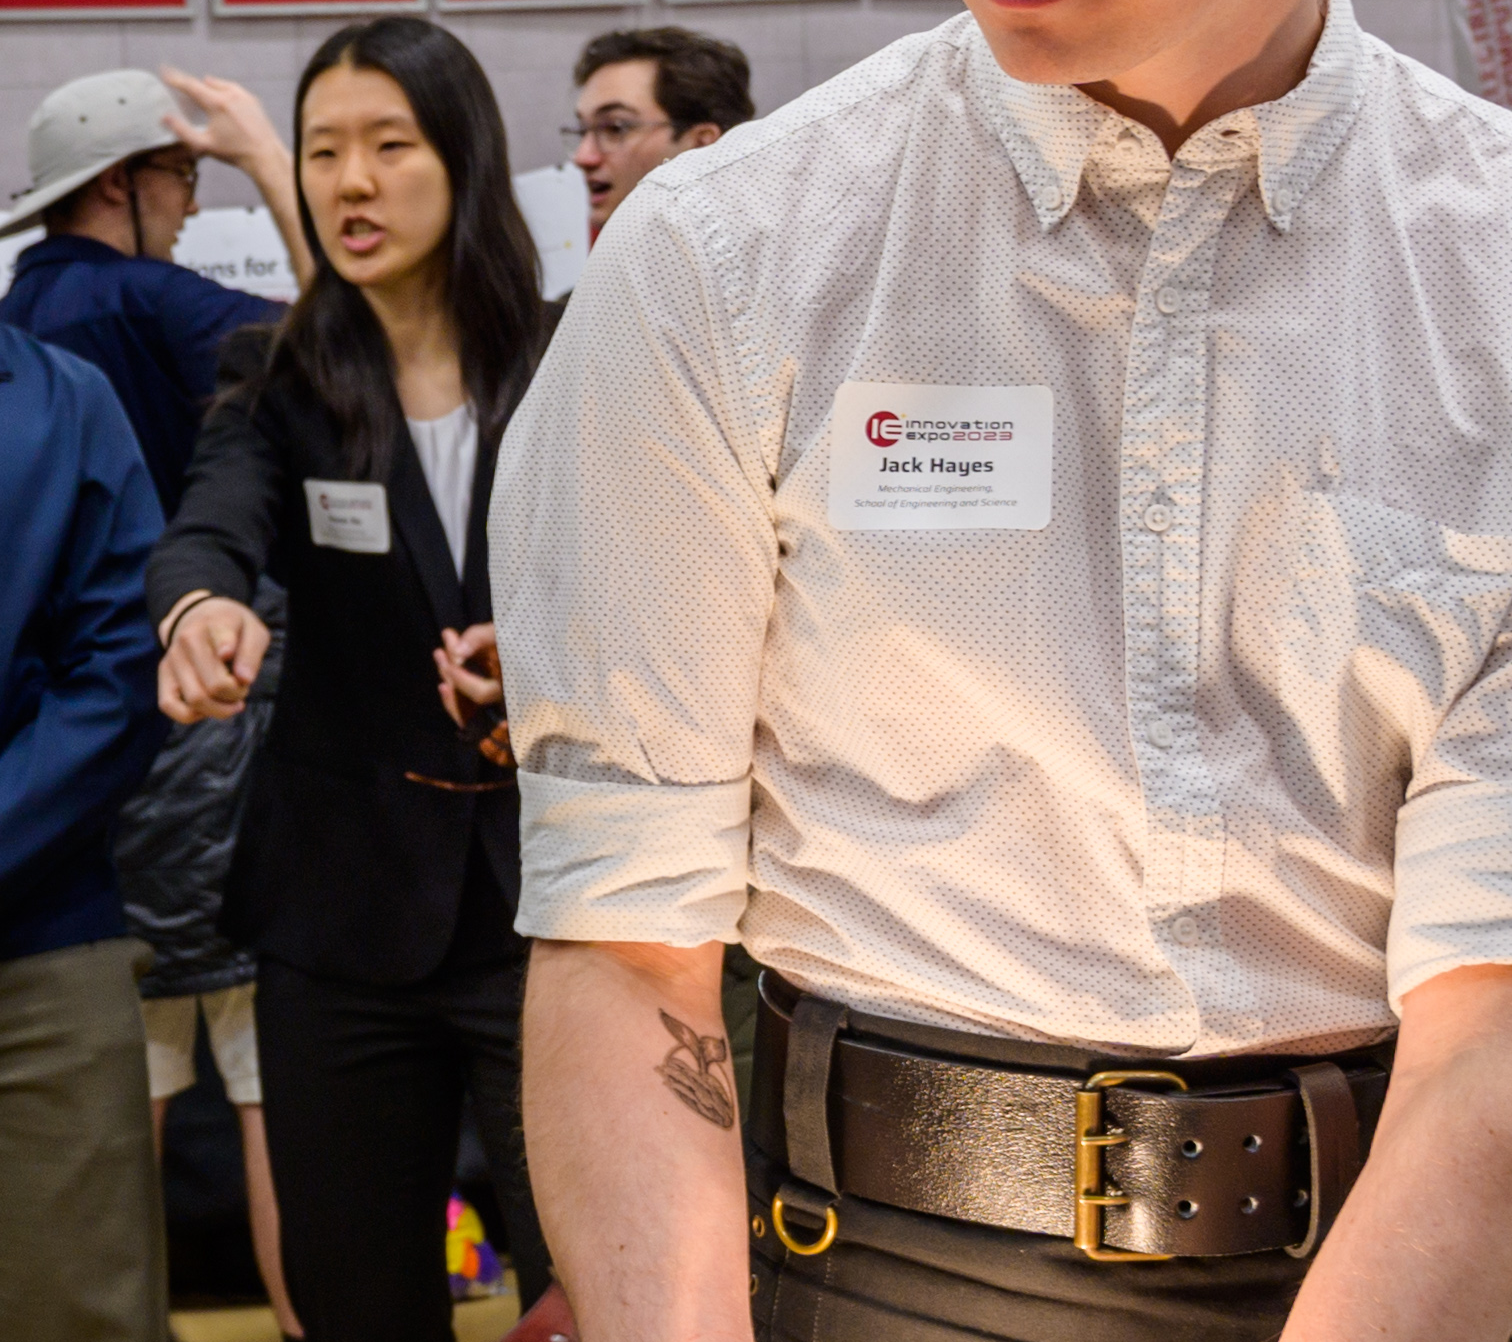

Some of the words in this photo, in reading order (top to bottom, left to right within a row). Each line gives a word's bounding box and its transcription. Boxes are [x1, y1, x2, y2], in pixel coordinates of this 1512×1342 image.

[244, 258, 278, 278] for
[905, 419, 1014, 430] innovation
[879, 457, 923, 473] Jack
[930, 458, 994, 476] Hayes
[877, 484, 932, 493] Mechanical
[854, 499, 886, 508] School
[888, 498, 898, 509] of
[900, 499, 957, 509] Engineering
[959, 498, 978, 507] and
[980, 497, 1017, 507] Science
